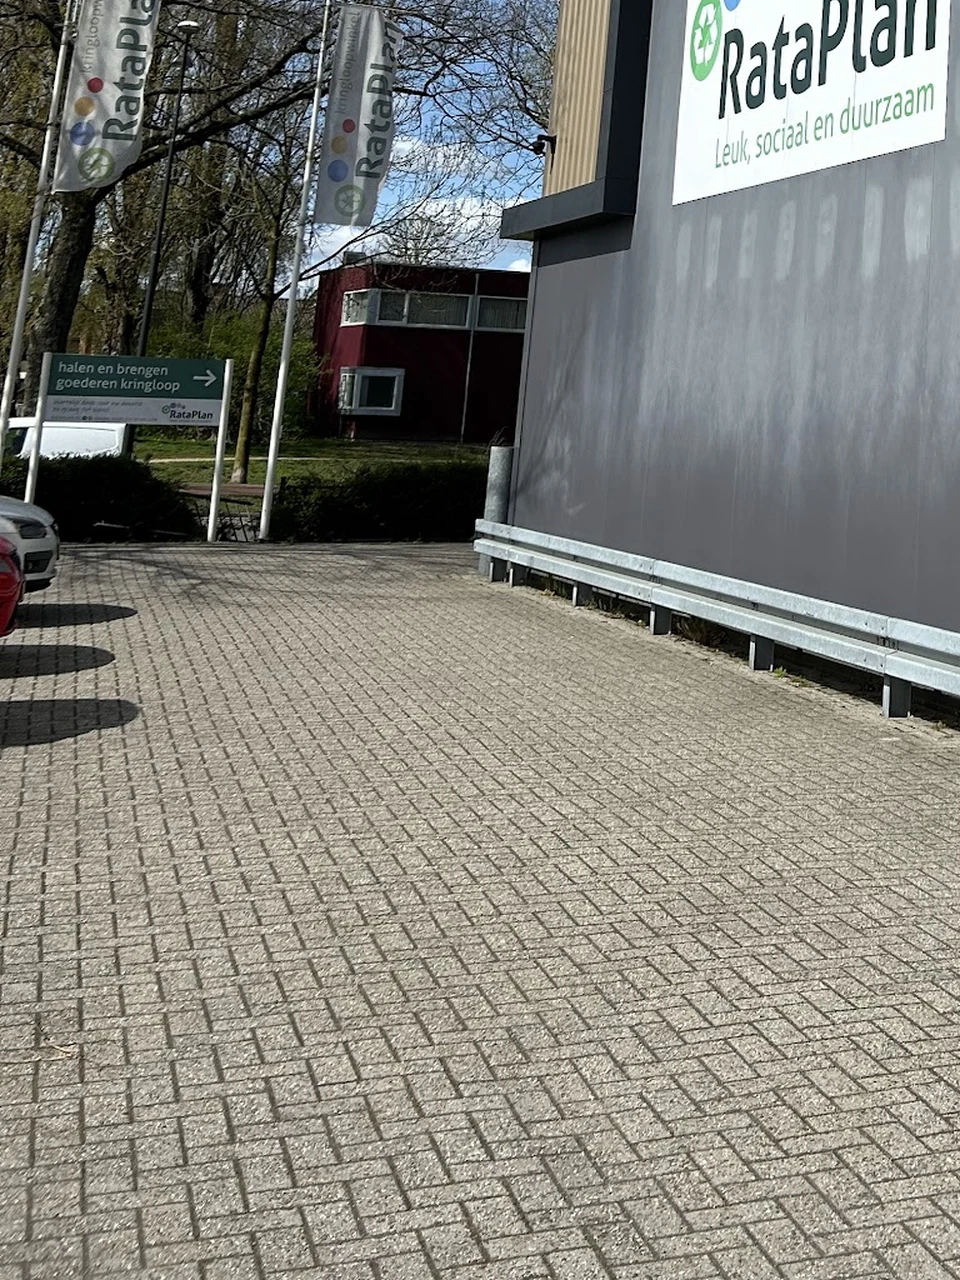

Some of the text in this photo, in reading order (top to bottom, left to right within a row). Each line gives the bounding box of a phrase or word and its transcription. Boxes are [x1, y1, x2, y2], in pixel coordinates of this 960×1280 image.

[335, 11, 361, 115] kringloopwinkel
[355, 21, 403, 179] RataPlan
[715, 82, 935, 168] Leuk, sociaal en duurzaam
[55, 377, 180, 393] goederen kringloop
[58, 361, 168, 378] halen en brengen
[169, 410, 213, 419] RataPlan
